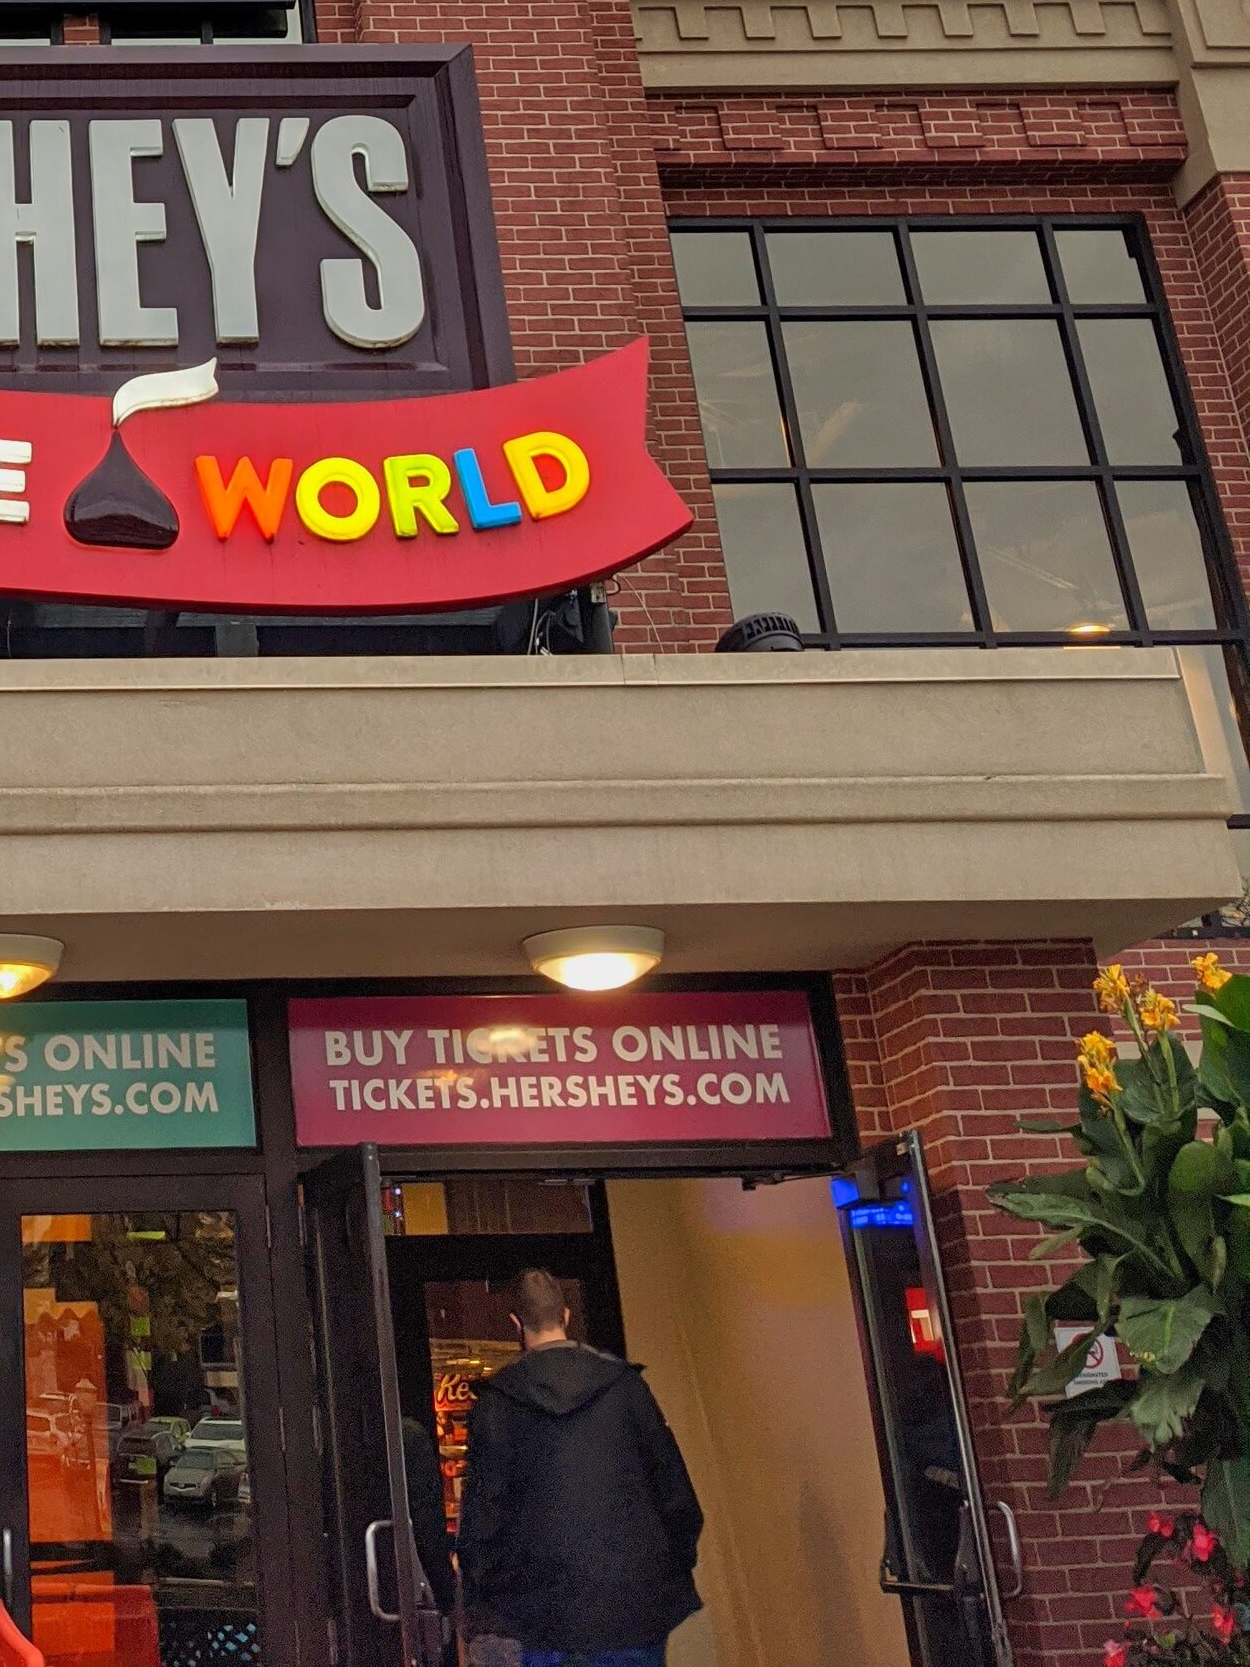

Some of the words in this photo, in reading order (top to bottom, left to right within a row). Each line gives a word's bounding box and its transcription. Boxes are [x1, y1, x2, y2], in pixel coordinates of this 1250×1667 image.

[194, 431, 591, 544] WORLD
[44, 1032, 217, 1071] ONLINE
[324, 1029, 416, 1067] BUY
[427, 1026, 596, 1065] TICKETS
[611, 1024, 784, 1062] ONLINE
[329, 1072, 791, 1111] TICKETS.HERSHEYS.COM
